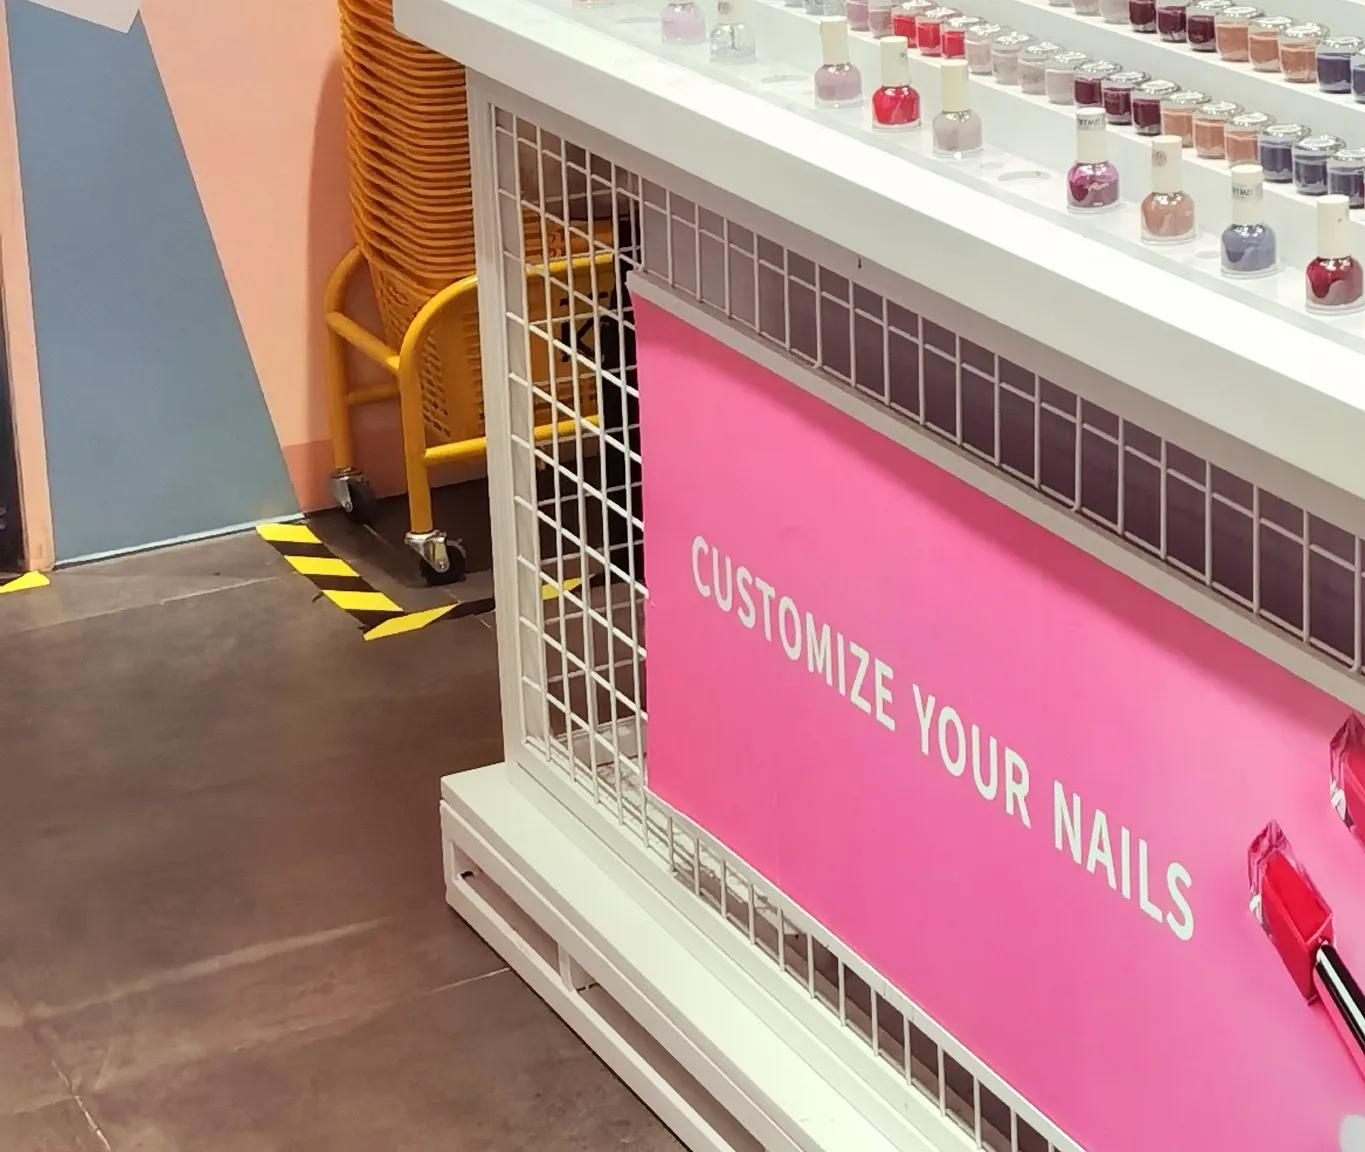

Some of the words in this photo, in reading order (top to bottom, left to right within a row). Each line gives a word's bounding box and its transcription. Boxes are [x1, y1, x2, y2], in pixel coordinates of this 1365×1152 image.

[692, 534, 897, 732] CUSTOMIZE
[911, 682, 1032, 829] YOUR
[1053, 779, 1196, 942] NAILS
